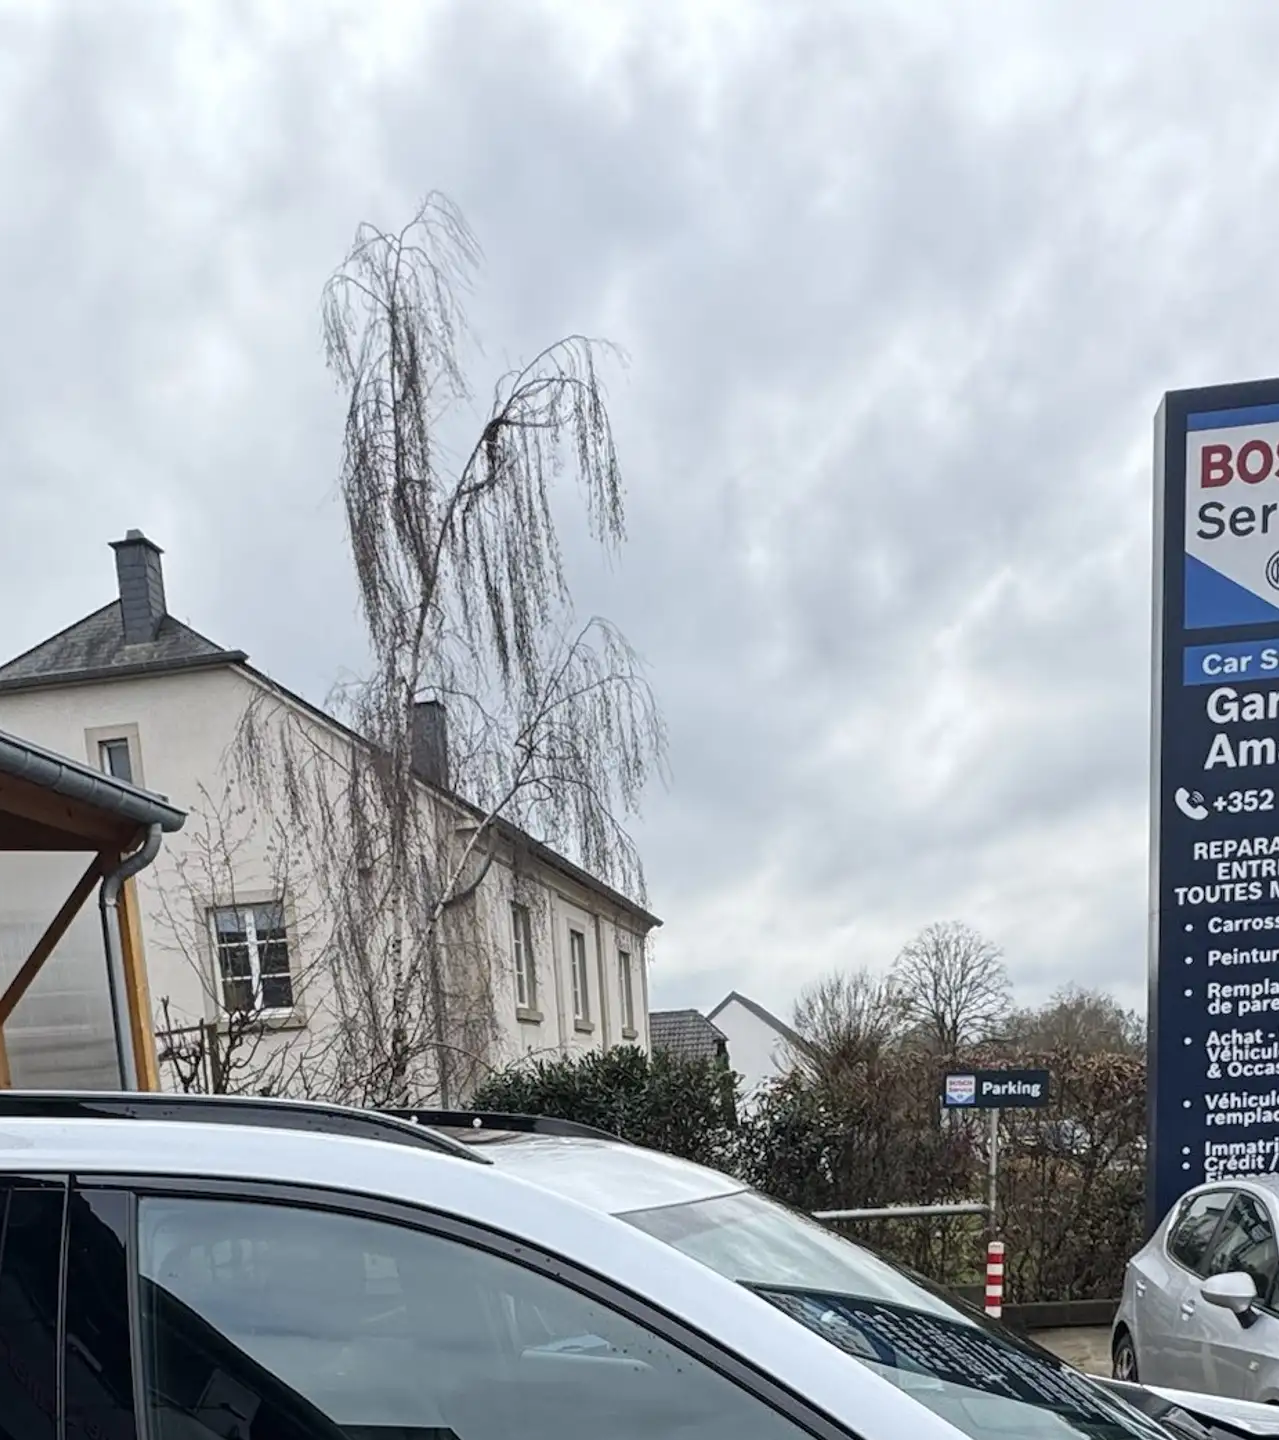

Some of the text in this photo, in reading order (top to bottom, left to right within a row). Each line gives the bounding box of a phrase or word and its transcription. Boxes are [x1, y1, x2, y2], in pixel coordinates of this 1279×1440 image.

[1202, 651, 1252, 676] Car
[1213, 788, 1274, 815] +352
[1174, 882, 1262, 905] TOUTES
[1207, 999, 1233, 1017] de
[1206, 1029, 1264, 1048] Achat
[1207, 1063, 1222, 1079] &
[982, 1080, 1041, 1097] Parking
[1203, 1154, 1266, 1172] Crédit
